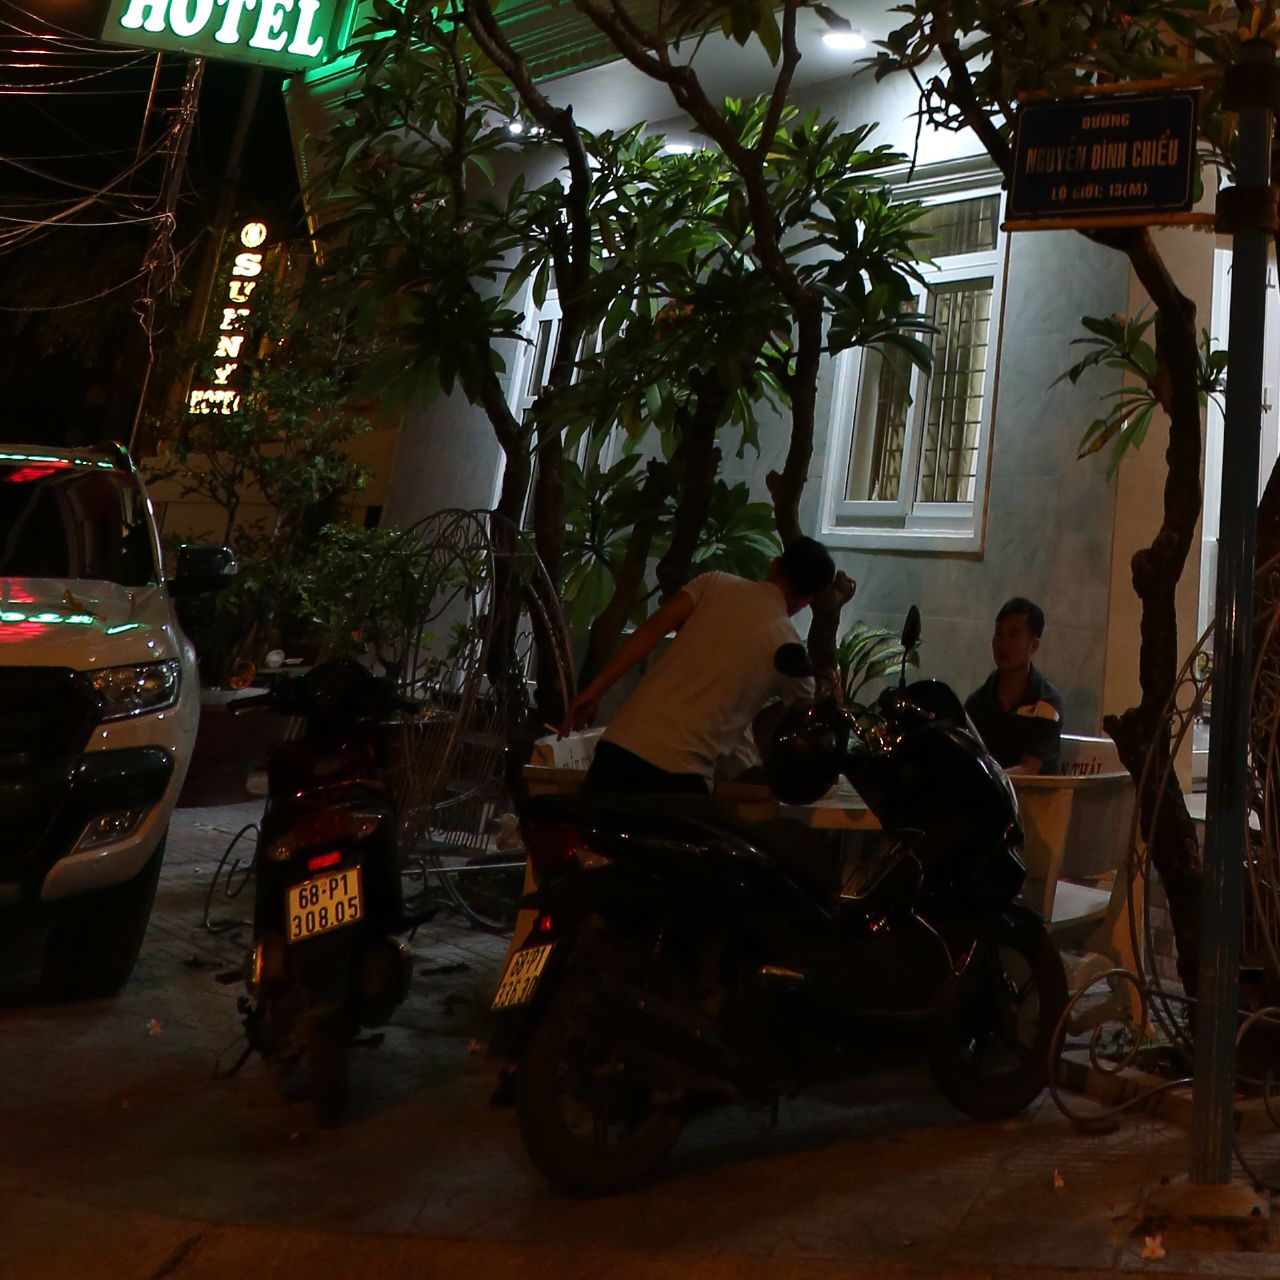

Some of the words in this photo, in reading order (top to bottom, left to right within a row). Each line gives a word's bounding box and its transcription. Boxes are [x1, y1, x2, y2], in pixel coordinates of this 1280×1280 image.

[1025, 134, 1088, 174] NGUYỄN
[298, 873, 349, 910] 68-P1
[292, 895, 359, 938] 308.05
